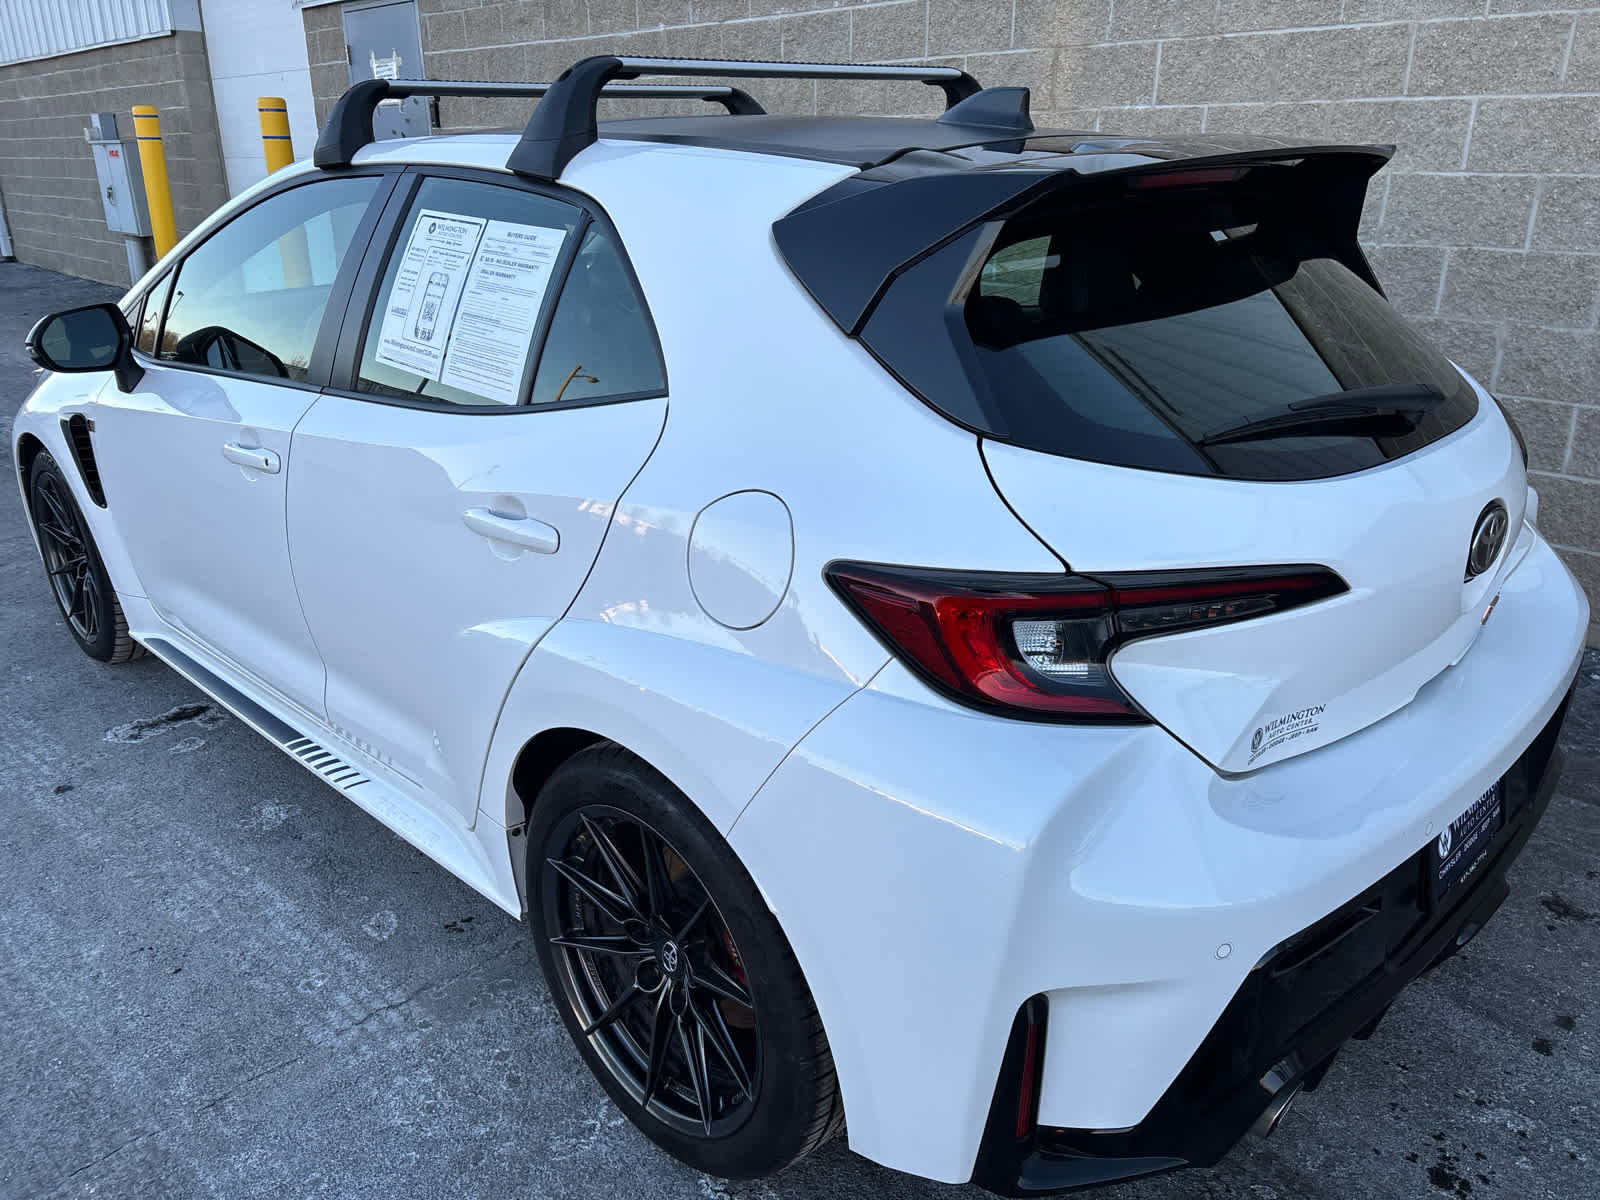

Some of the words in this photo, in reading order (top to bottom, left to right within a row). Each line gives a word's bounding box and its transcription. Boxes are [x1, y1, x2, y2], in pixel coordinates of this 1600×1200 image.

[1264, 704, 1327, 732] WILMINGTON
[1269, 726, 1285, 738] AUTO
[1286, 718, 1313, 731] CENTER
